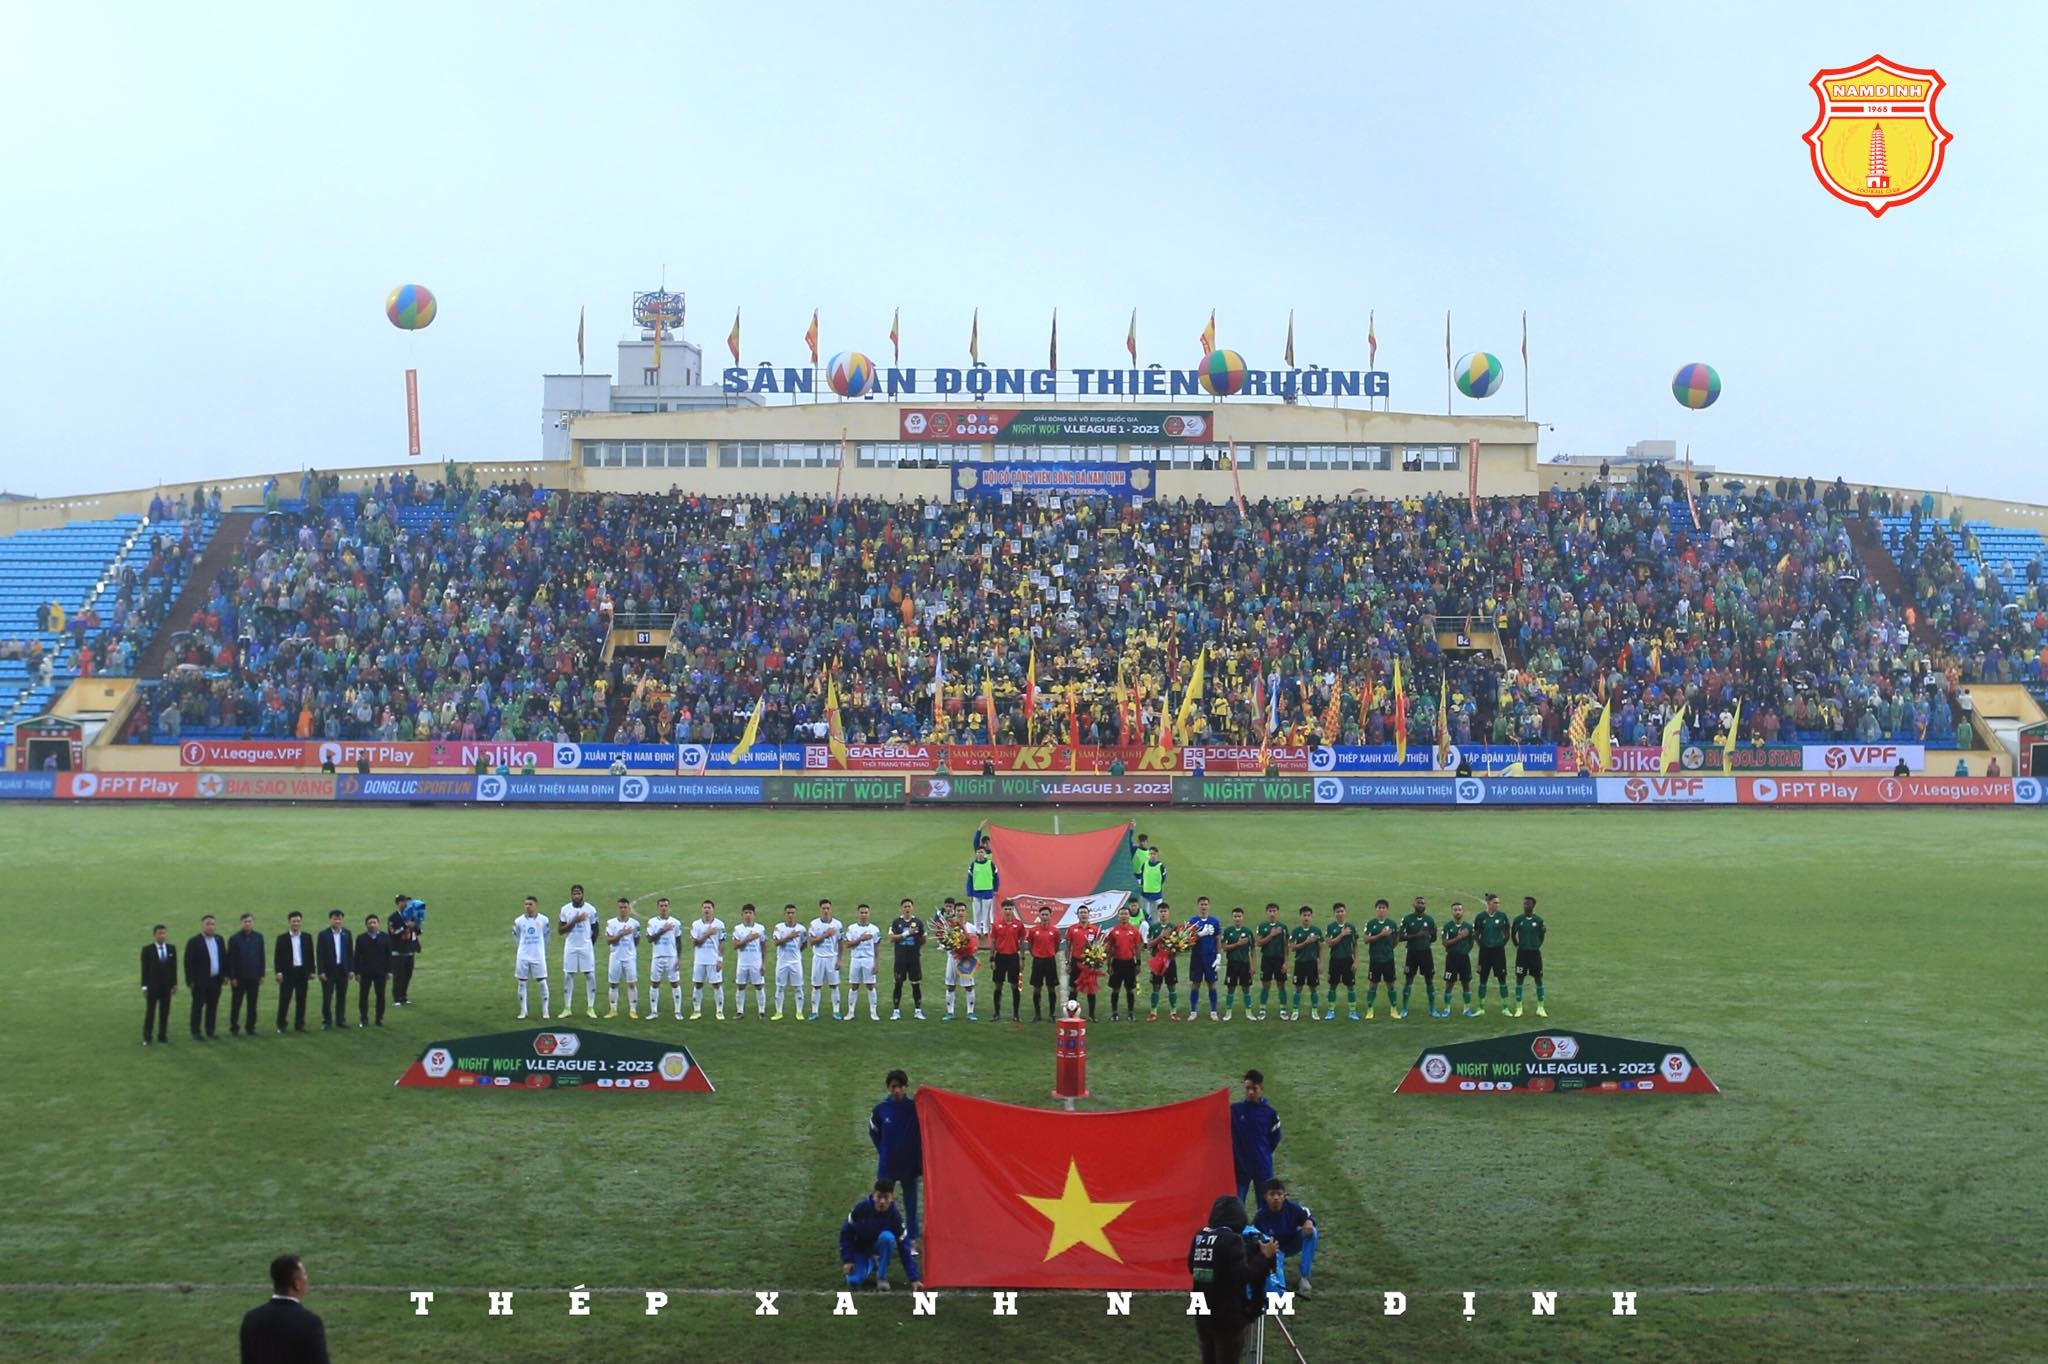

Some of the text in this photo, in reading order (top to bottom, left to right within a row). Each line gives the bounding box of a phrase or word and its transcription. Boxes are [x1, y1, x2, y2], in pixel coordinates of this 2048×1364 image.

[723, 362, 813, 394] SÂN
[935, 362, 1057, 401] ĐỘNG
[1072, 363, 1200, 395] THIÊN
[1242, 364, 1389, 397] RƯỜNG
[1012, 424, 1036, 434] NIGHT
[1039, 424, 1060, 434] WOLF
[1064, 425, 1116, 434] V.LEAGUE
[1118, 425, 1125, 433] 1
[1132, 425, 1159, 434] 2023
[211, 747, 303, 762] V.League.VPF
[380, 747, 414, 767] Play
[637, 752, 653, 761] NAM
[1360, 754, 1381, 763] XANH
[1850, 747, 1897, 763] VPF
[100, 778, 180, 795] FPT Play
[255, 779, 288, 793] SAO
[567, 784, 589, 794] NAM
[793, 783, 903, 800] NIGHT WOLF
[954, 779, 996, 795] NIGHT
[1001, 778, 1041, 795] WOLF
[1041, 784, 1112, 794] V.LEAGUE
[1115, 784, 1123, 794] 1
[1134, 783, 1170, 794] 2023
[1203, 783, 1312, 800] NIGHT WOLF
[1374, 785, 1399, 795] XANH
[1650, 777, 1703, 796] VPF
[1782, 782, 1859, 799] FPT Play
[1909, 783, 2011, 798] V.League.VPF
[457, 1058, 489, 1071] NIGHT
[493, 1058, 522, 1071] WOLF
[526, 1060, 596, 1071] V.LEAGUE
[598, 1061, 607, 1071] 1
[617, 1061, 654, 1072] 2023
[1456, 1063, 1488, 1076] NIGHT
[1492, 1063, 1522, 1075] WOLF
[1525, 1063, 1599, 1074] V.LEAGUE
[1601, 1063, 1609, 1074] 1
[1619, 1063, 1656, 1074] 2023
